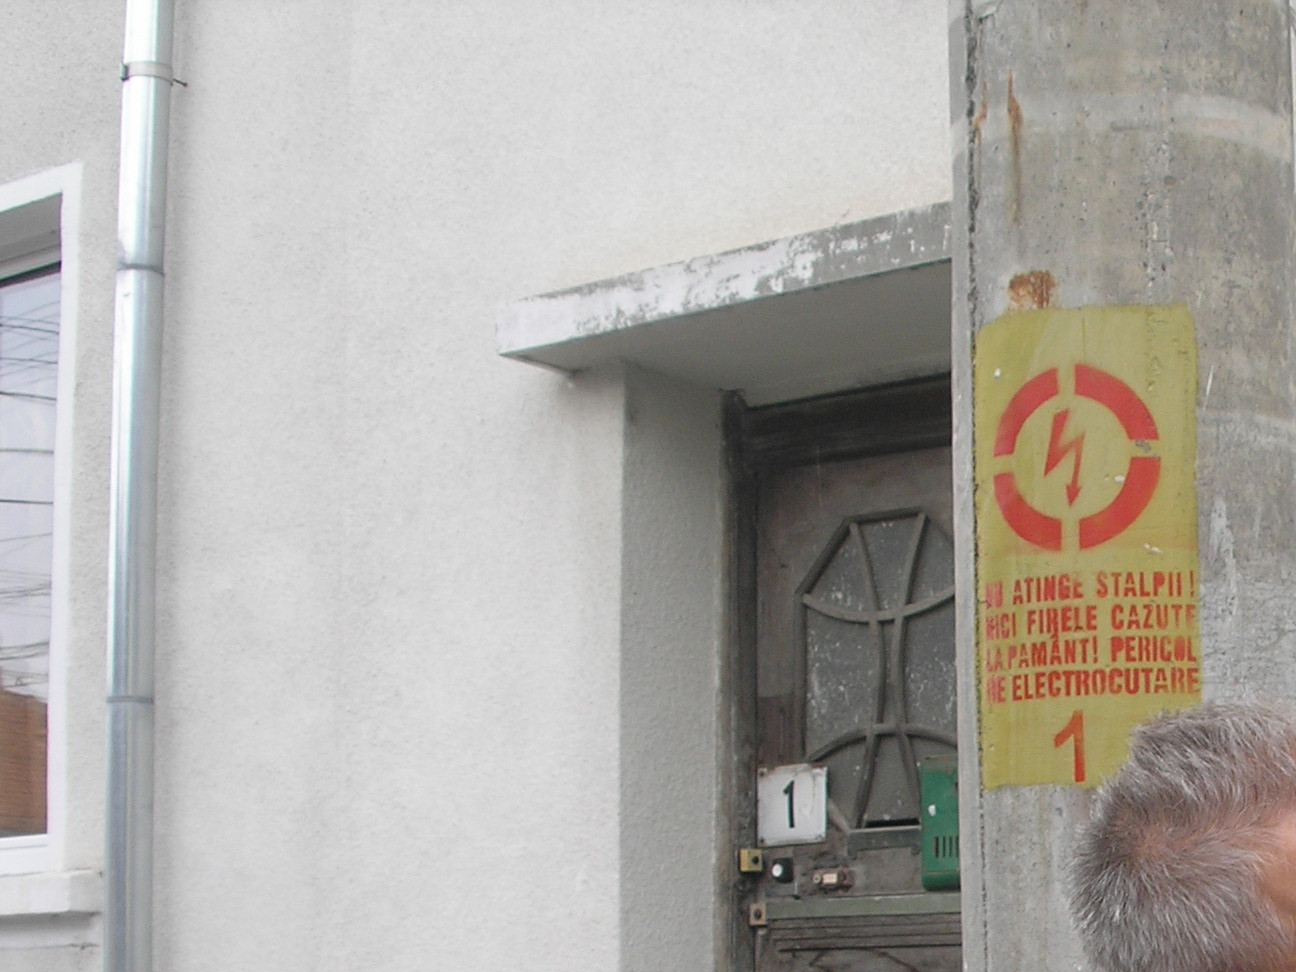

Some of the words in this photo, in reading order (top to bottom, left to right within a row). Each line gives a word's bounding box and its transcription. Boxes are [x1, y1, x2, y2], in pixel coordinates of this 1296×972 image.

[1012, 572, 1084, 606] ATINGE
[1027, 605, 1097, 635] FIRELE
[1111, 603, 1196, 631] CAZUTE
[986, 645, 1003, 673] LA
[1110, 636, 1197, 663] PERICOL
[1012, 667, 1200, 702] ELECTROCUTARE
[1053, 709, 1086, 783] 1
[783, 780, 795, 828] 1
